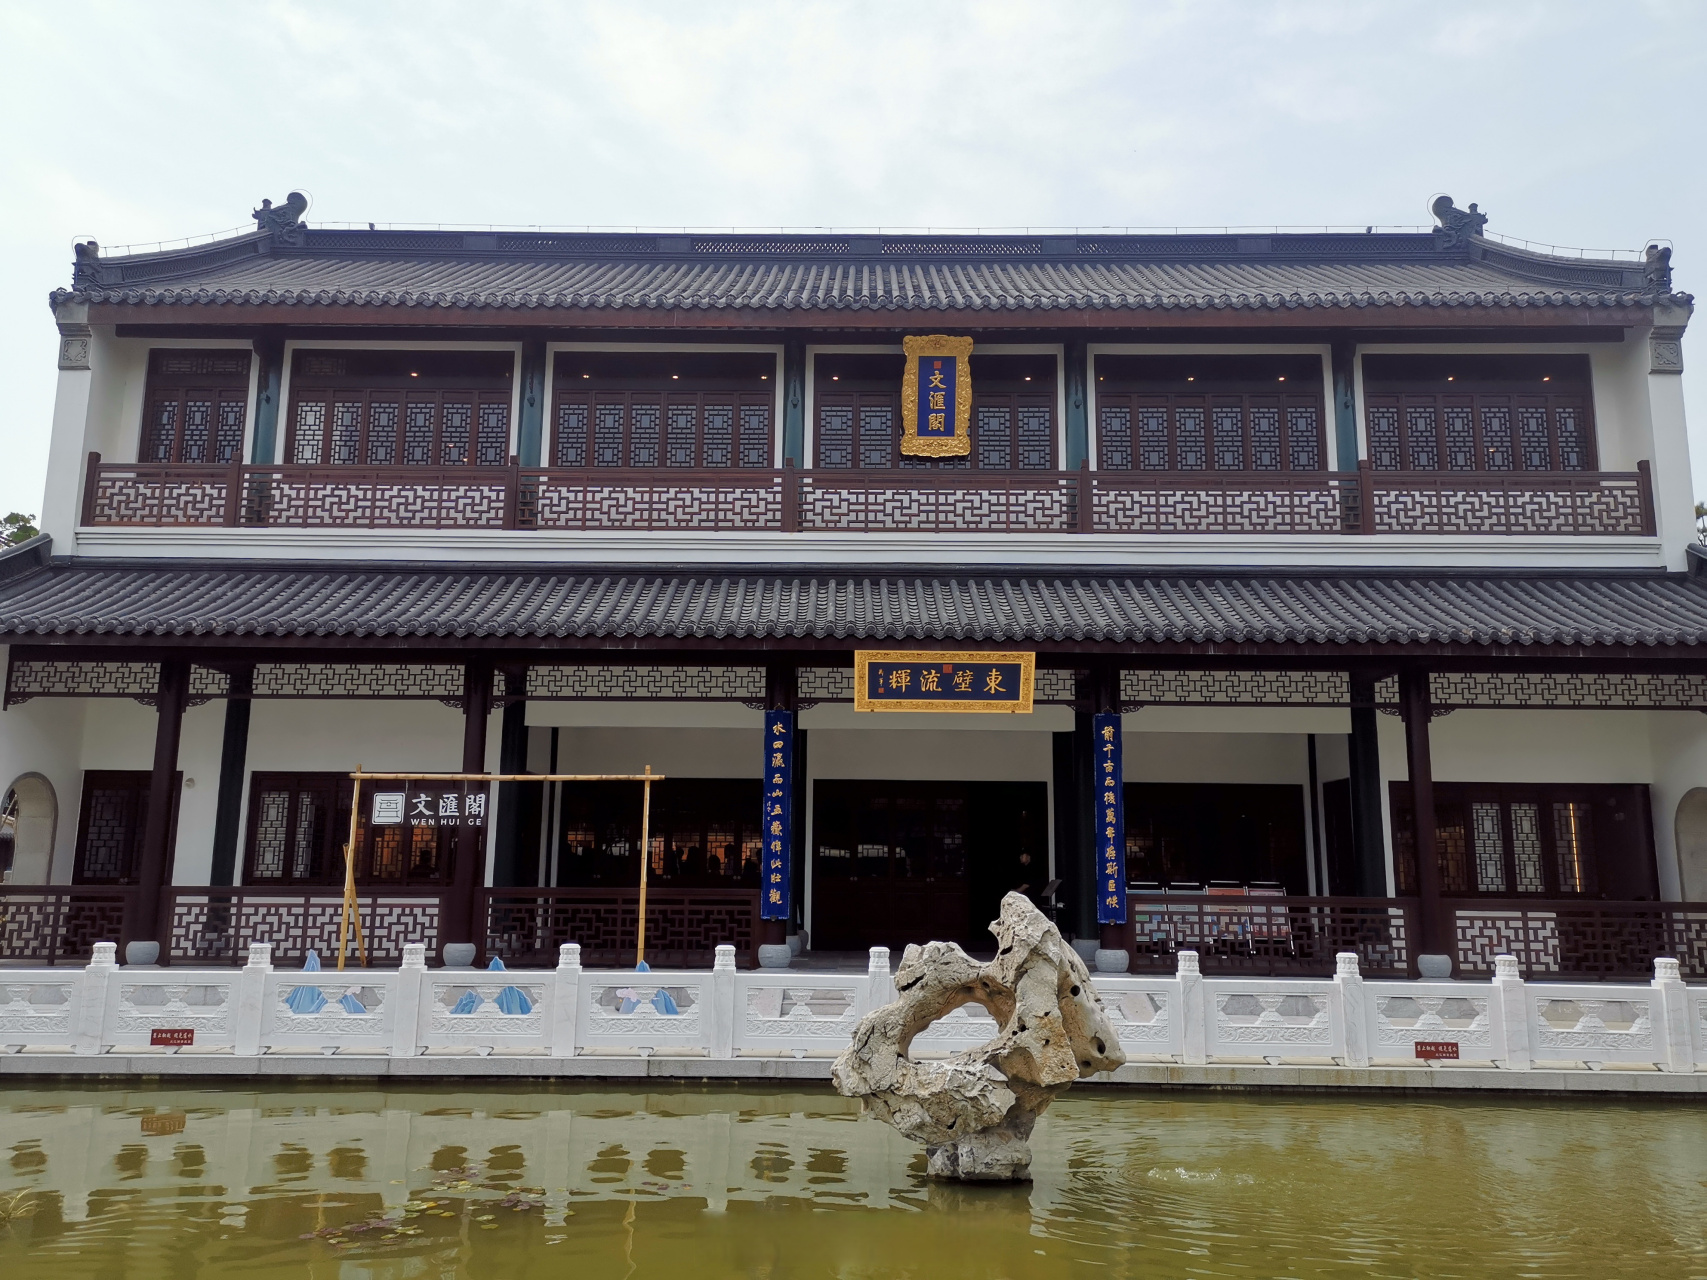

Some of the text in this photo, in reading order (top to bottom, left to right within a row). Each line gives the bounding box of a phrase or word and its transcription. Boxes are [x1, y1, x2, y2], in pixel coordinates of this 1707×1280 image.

[928, 370, 947, 432] 文匯閣
[409, 793, 486, 818] 文匯閣
[410, 818, 482, 826] WEN HUI GE
